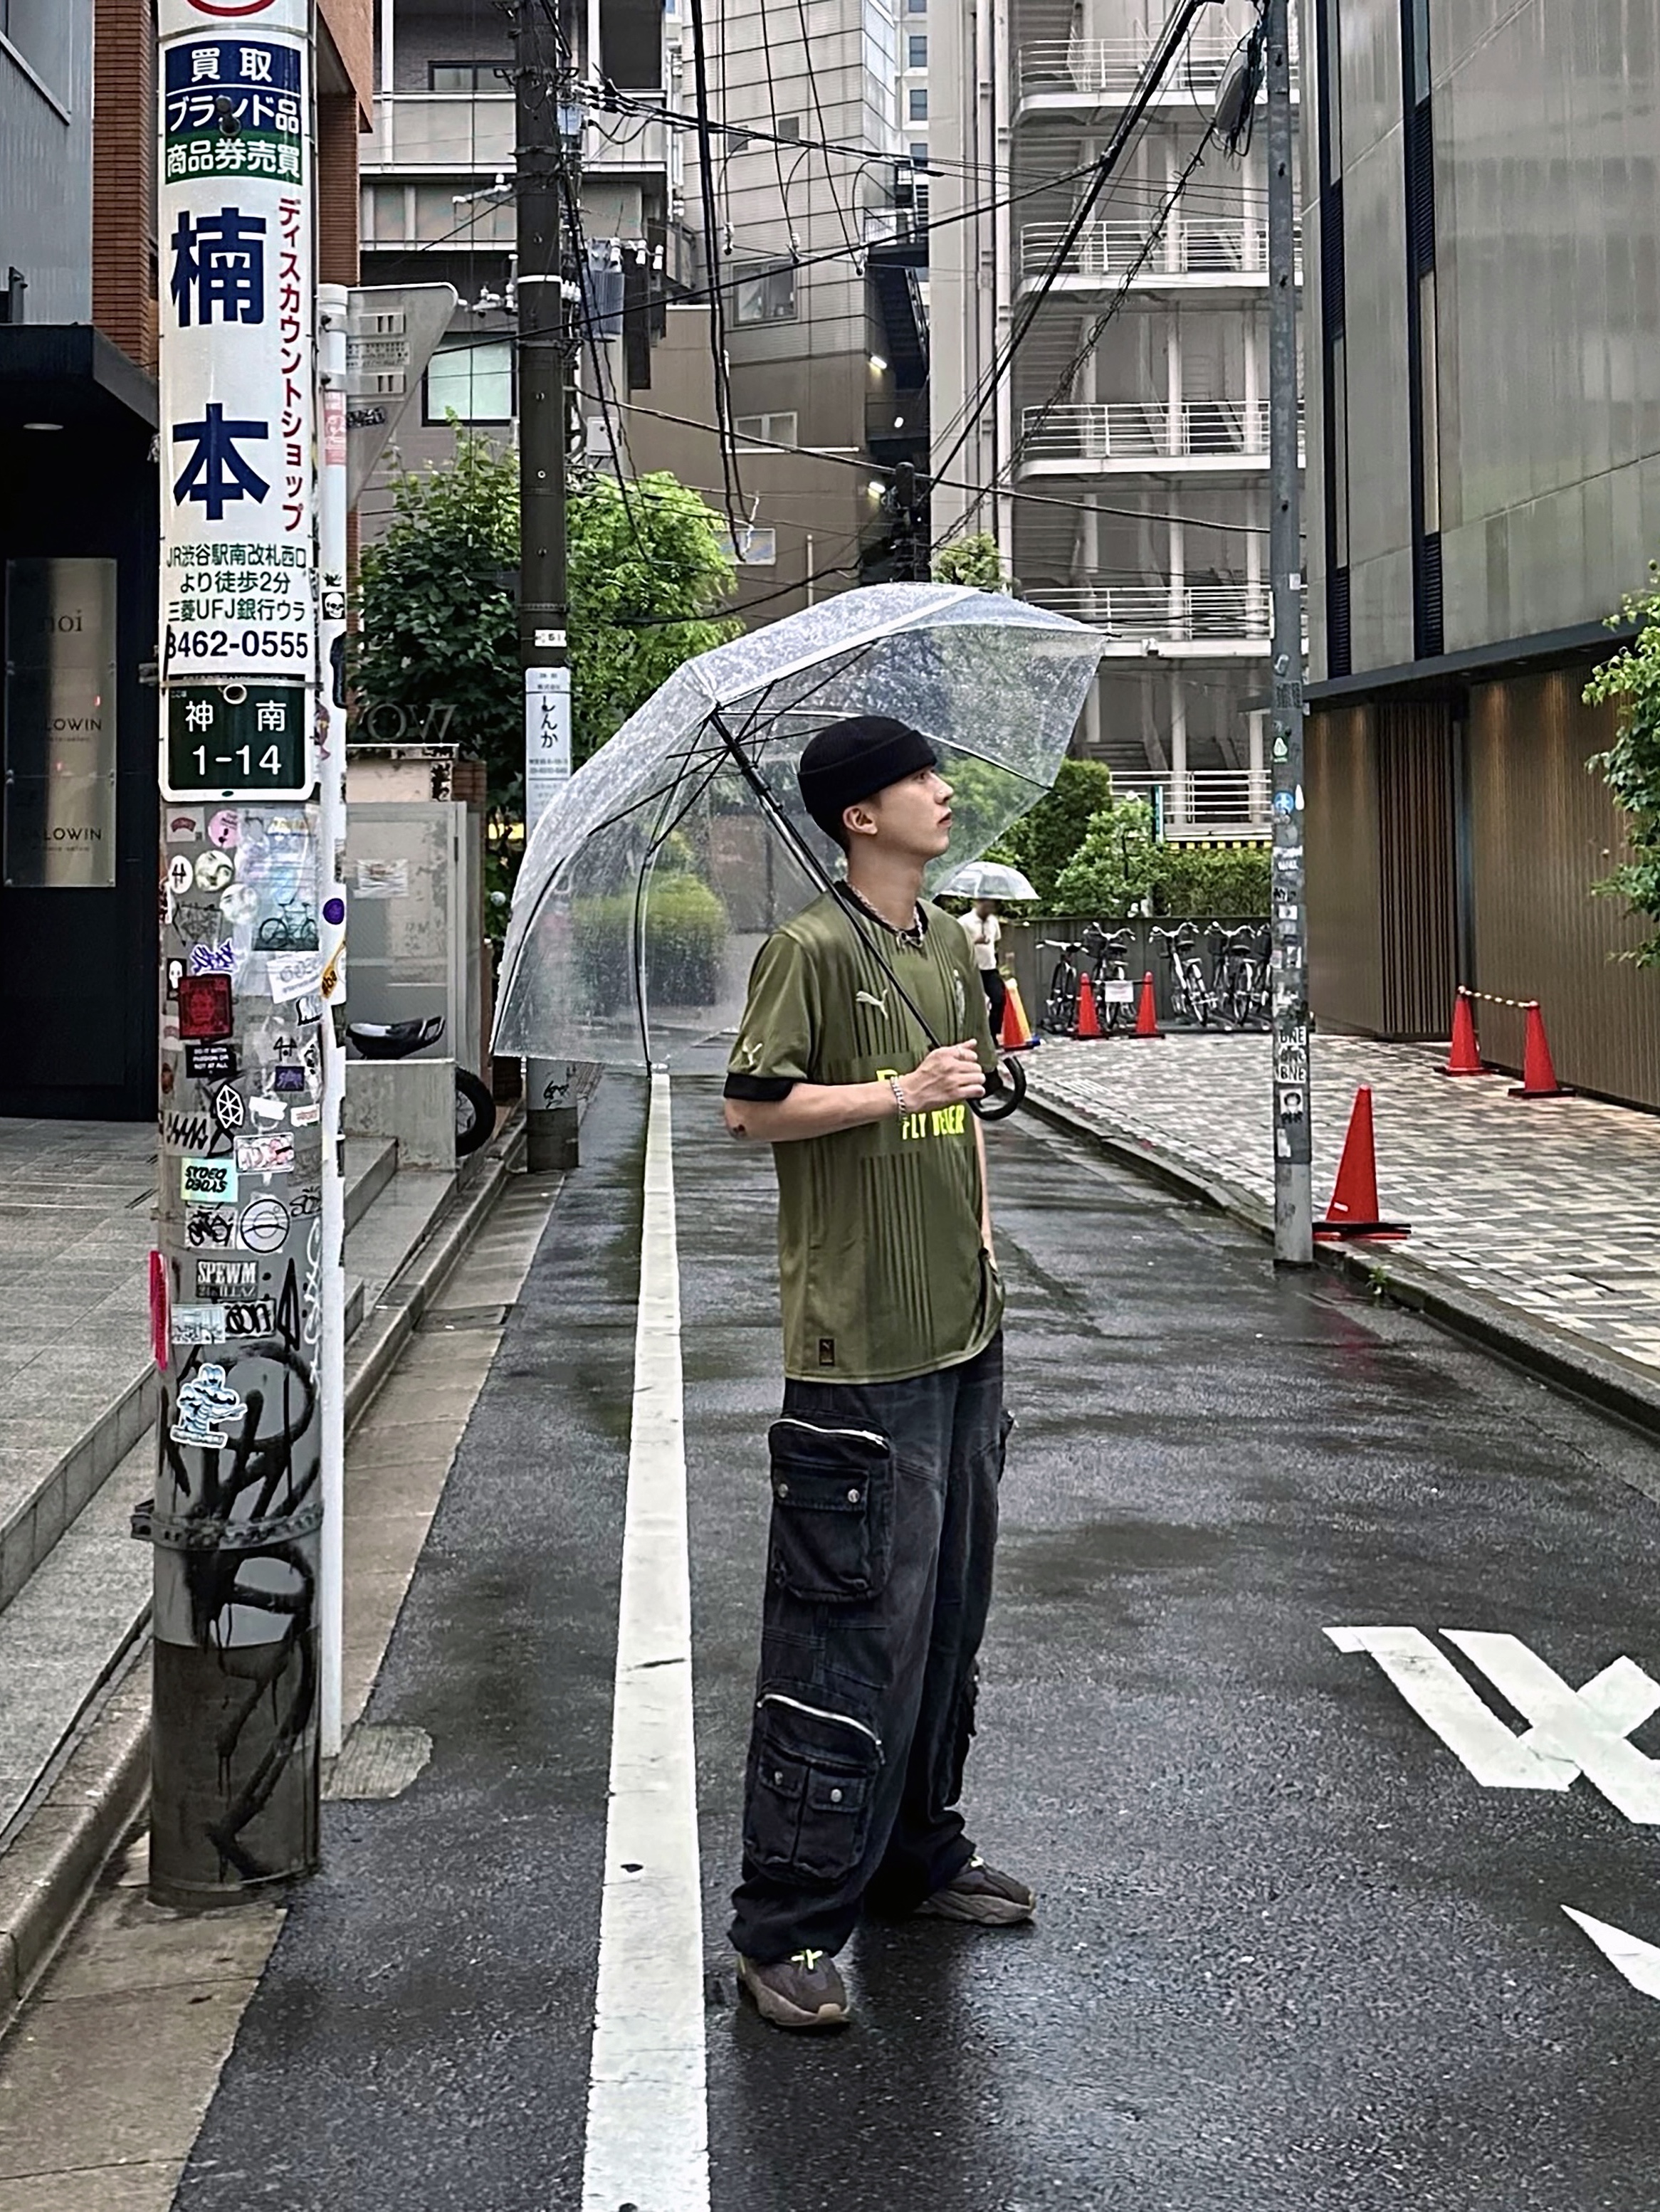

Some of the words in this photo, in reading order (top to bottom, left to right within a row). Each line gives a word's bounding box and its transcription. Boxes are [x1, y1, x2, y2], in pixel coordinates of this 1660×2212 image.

[191, 47, 273, 83] 買取
[167, 139, 300, 178] 商品券売買
[171, 207, 270, 520] 楠本
[278, 198, 303, 532] ディスカウントショップ
[167, 543, 306, 569] JR渋谷駅南改札西口
[180, 570, 291, 594] より徒歩2分
[168, 598, 305, 622] 三菱UFJ銀行ウラ
[185, 700, 287, 732] 神南
[540, 695, 560, 749] しんか
[192, 744, 282, 776] 1-14
